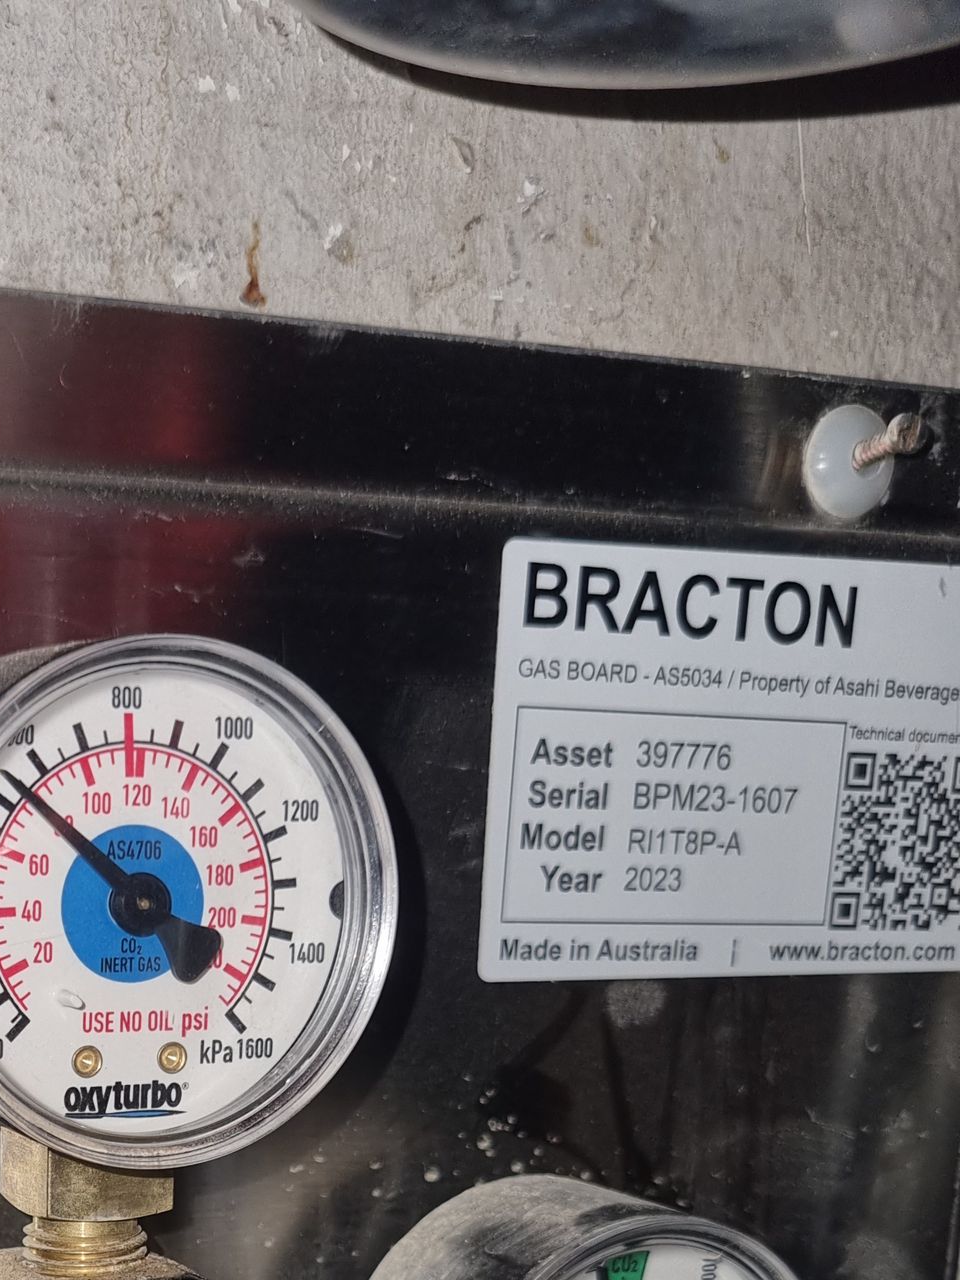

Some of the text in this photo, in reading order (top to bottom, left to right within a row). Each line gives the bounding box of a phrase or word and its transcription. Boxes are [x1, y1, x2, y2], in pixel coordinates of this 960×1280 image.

[522, 561, 858, 649] BRACTON
[518, 658, 561, 679] GAS
[567, 660, 638, 684] BOARD
[653, 665, 723, 688] AS5034
[739, 671, 810, 698] Property
[814, 676, 831, 694] of
[833, 677, 880, 698] Asahi
[112, 686, 142, 709] 800
[7, 724, 35, 747] 00
[215, 716, 253, 740] 1000
[849, 726, 905, 742] Technical
[530, 739, 732, 771] Asset 397776
[82, 792, 111, 815] 100
[122, 784, 151, 807] 120
[528, 780, 799, 814] Serial BPM23-1607
[161, 797, 190, 819] 140
[282, 800, 319, 822] 1200
[190, 826, 218, 848] 160
[520, 823, 742, 856] Model RI1T8P-A
[106, 839, 162, 861] AS4706
[29, 854, 49, 876] 60
[206, 864, 234, 886] 180
[541, 866, 682, 893] Year 2023
[21, 900, 42, 922] 40
[208, 907, 236, 929] 200
[33, 941, 53, 963] 20
[289, 942, 325, 964] 1400
[499, 937, 698, 962] Made in Australia
[770, 939, 956, 962] www.bracton.com
[100, 956, 161, 973] INERT GAS
[82, 1006, 209, 1037] USE NO OIL psi
[200, 1040, 233, 1064] kPa
[237, 1038, 273, 1059] 1600
